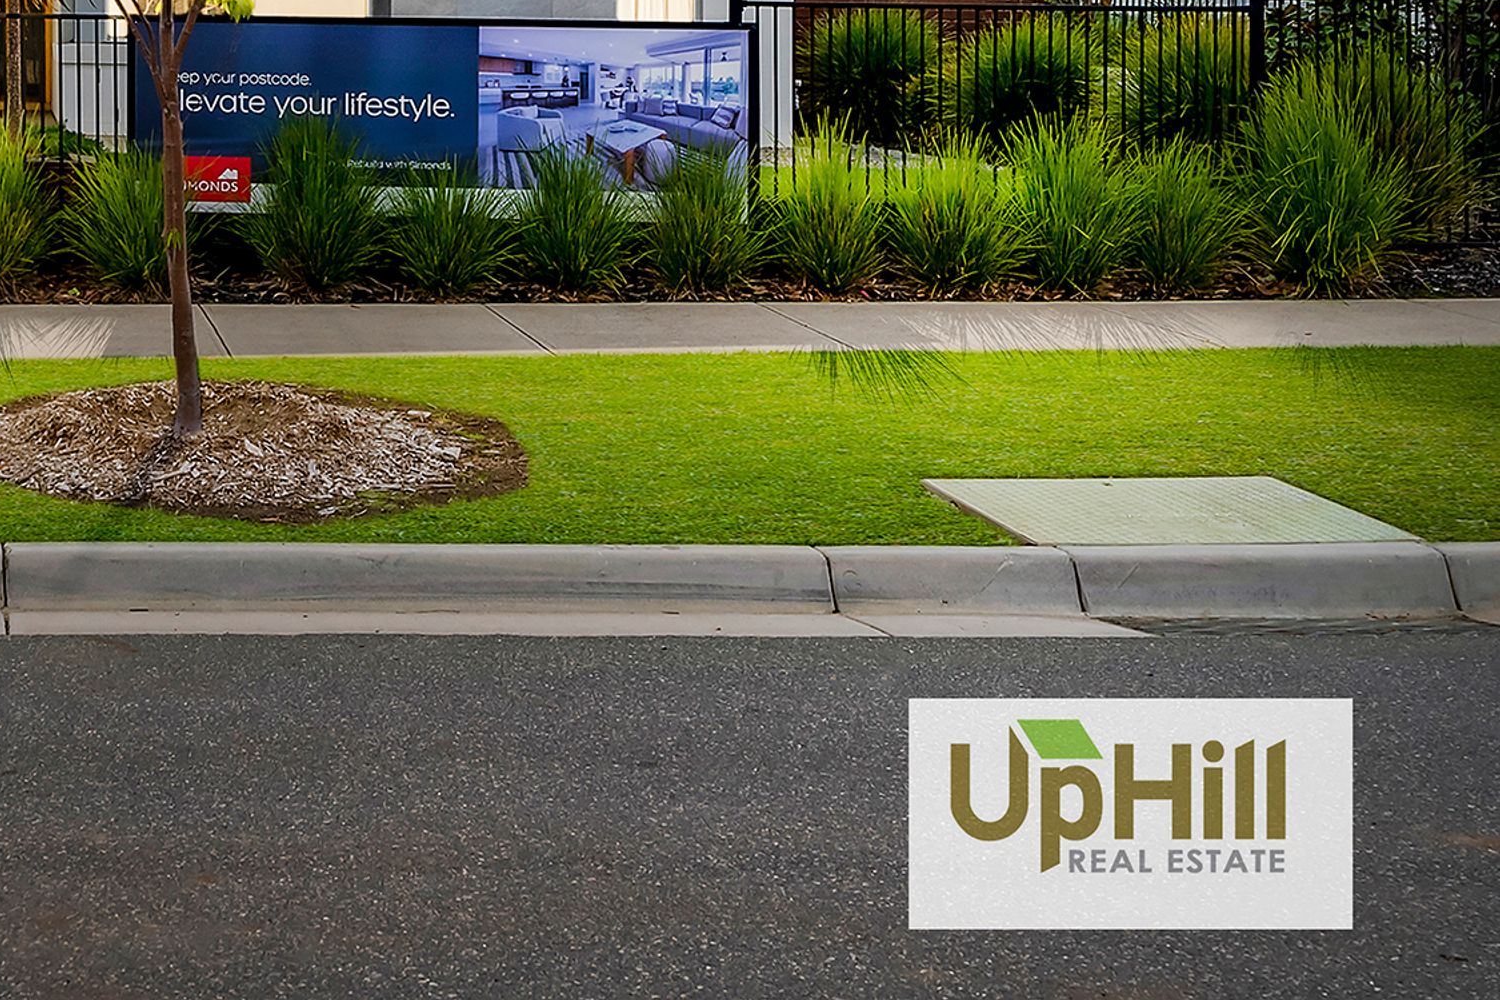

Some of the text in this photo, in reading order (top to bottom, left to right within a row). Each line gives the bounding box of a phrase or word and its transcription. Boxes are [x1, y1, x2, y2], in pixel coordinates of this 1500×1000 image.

[202, 73, 237, 86] your
[238, 72, 313, 87] postcode.
[179, 88, 456, 123] levate your lifestyle.
[182, 180, 239, 192] IMONDS
